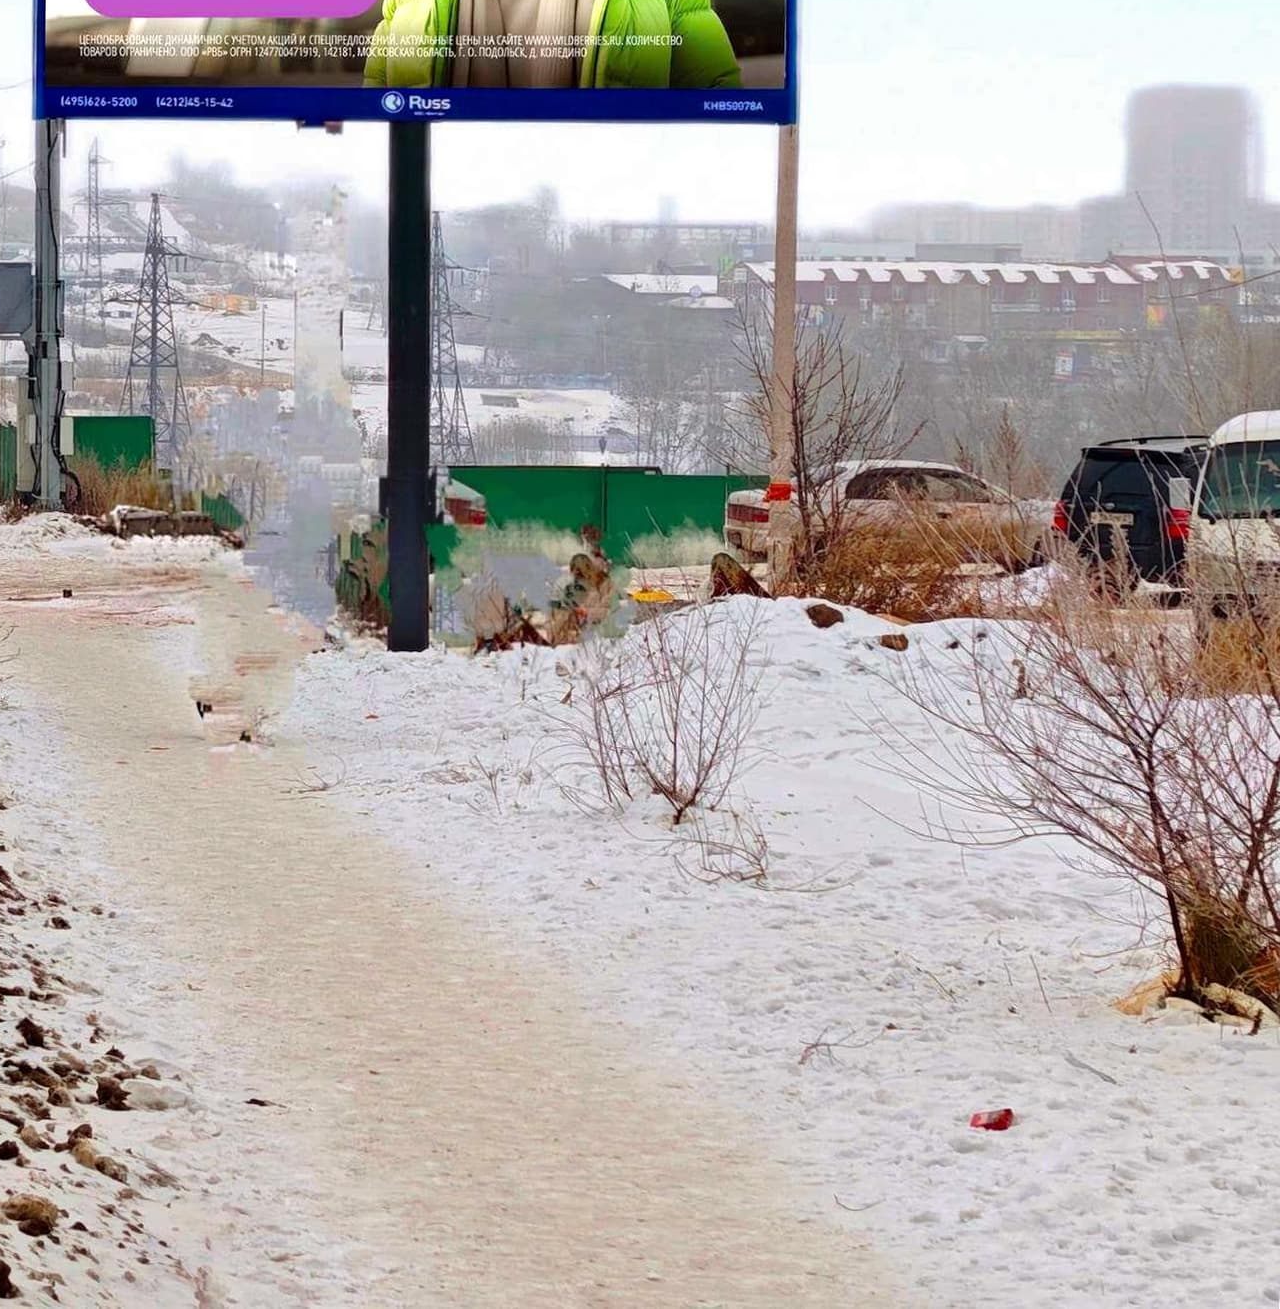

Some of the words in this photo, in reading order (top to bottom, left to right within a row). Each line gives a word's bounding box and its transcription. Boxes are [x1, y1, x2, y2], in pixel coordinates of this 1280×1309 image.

[483, 35, 495, 46] НА
[625, 35, 683, 46] КОЛИЧЕСТВО
[79, 46, 118, 57] ТОВАРОВ
[60, 95, 138, 107] (495)626-5200
[409, 95, 451, 110] Russ
